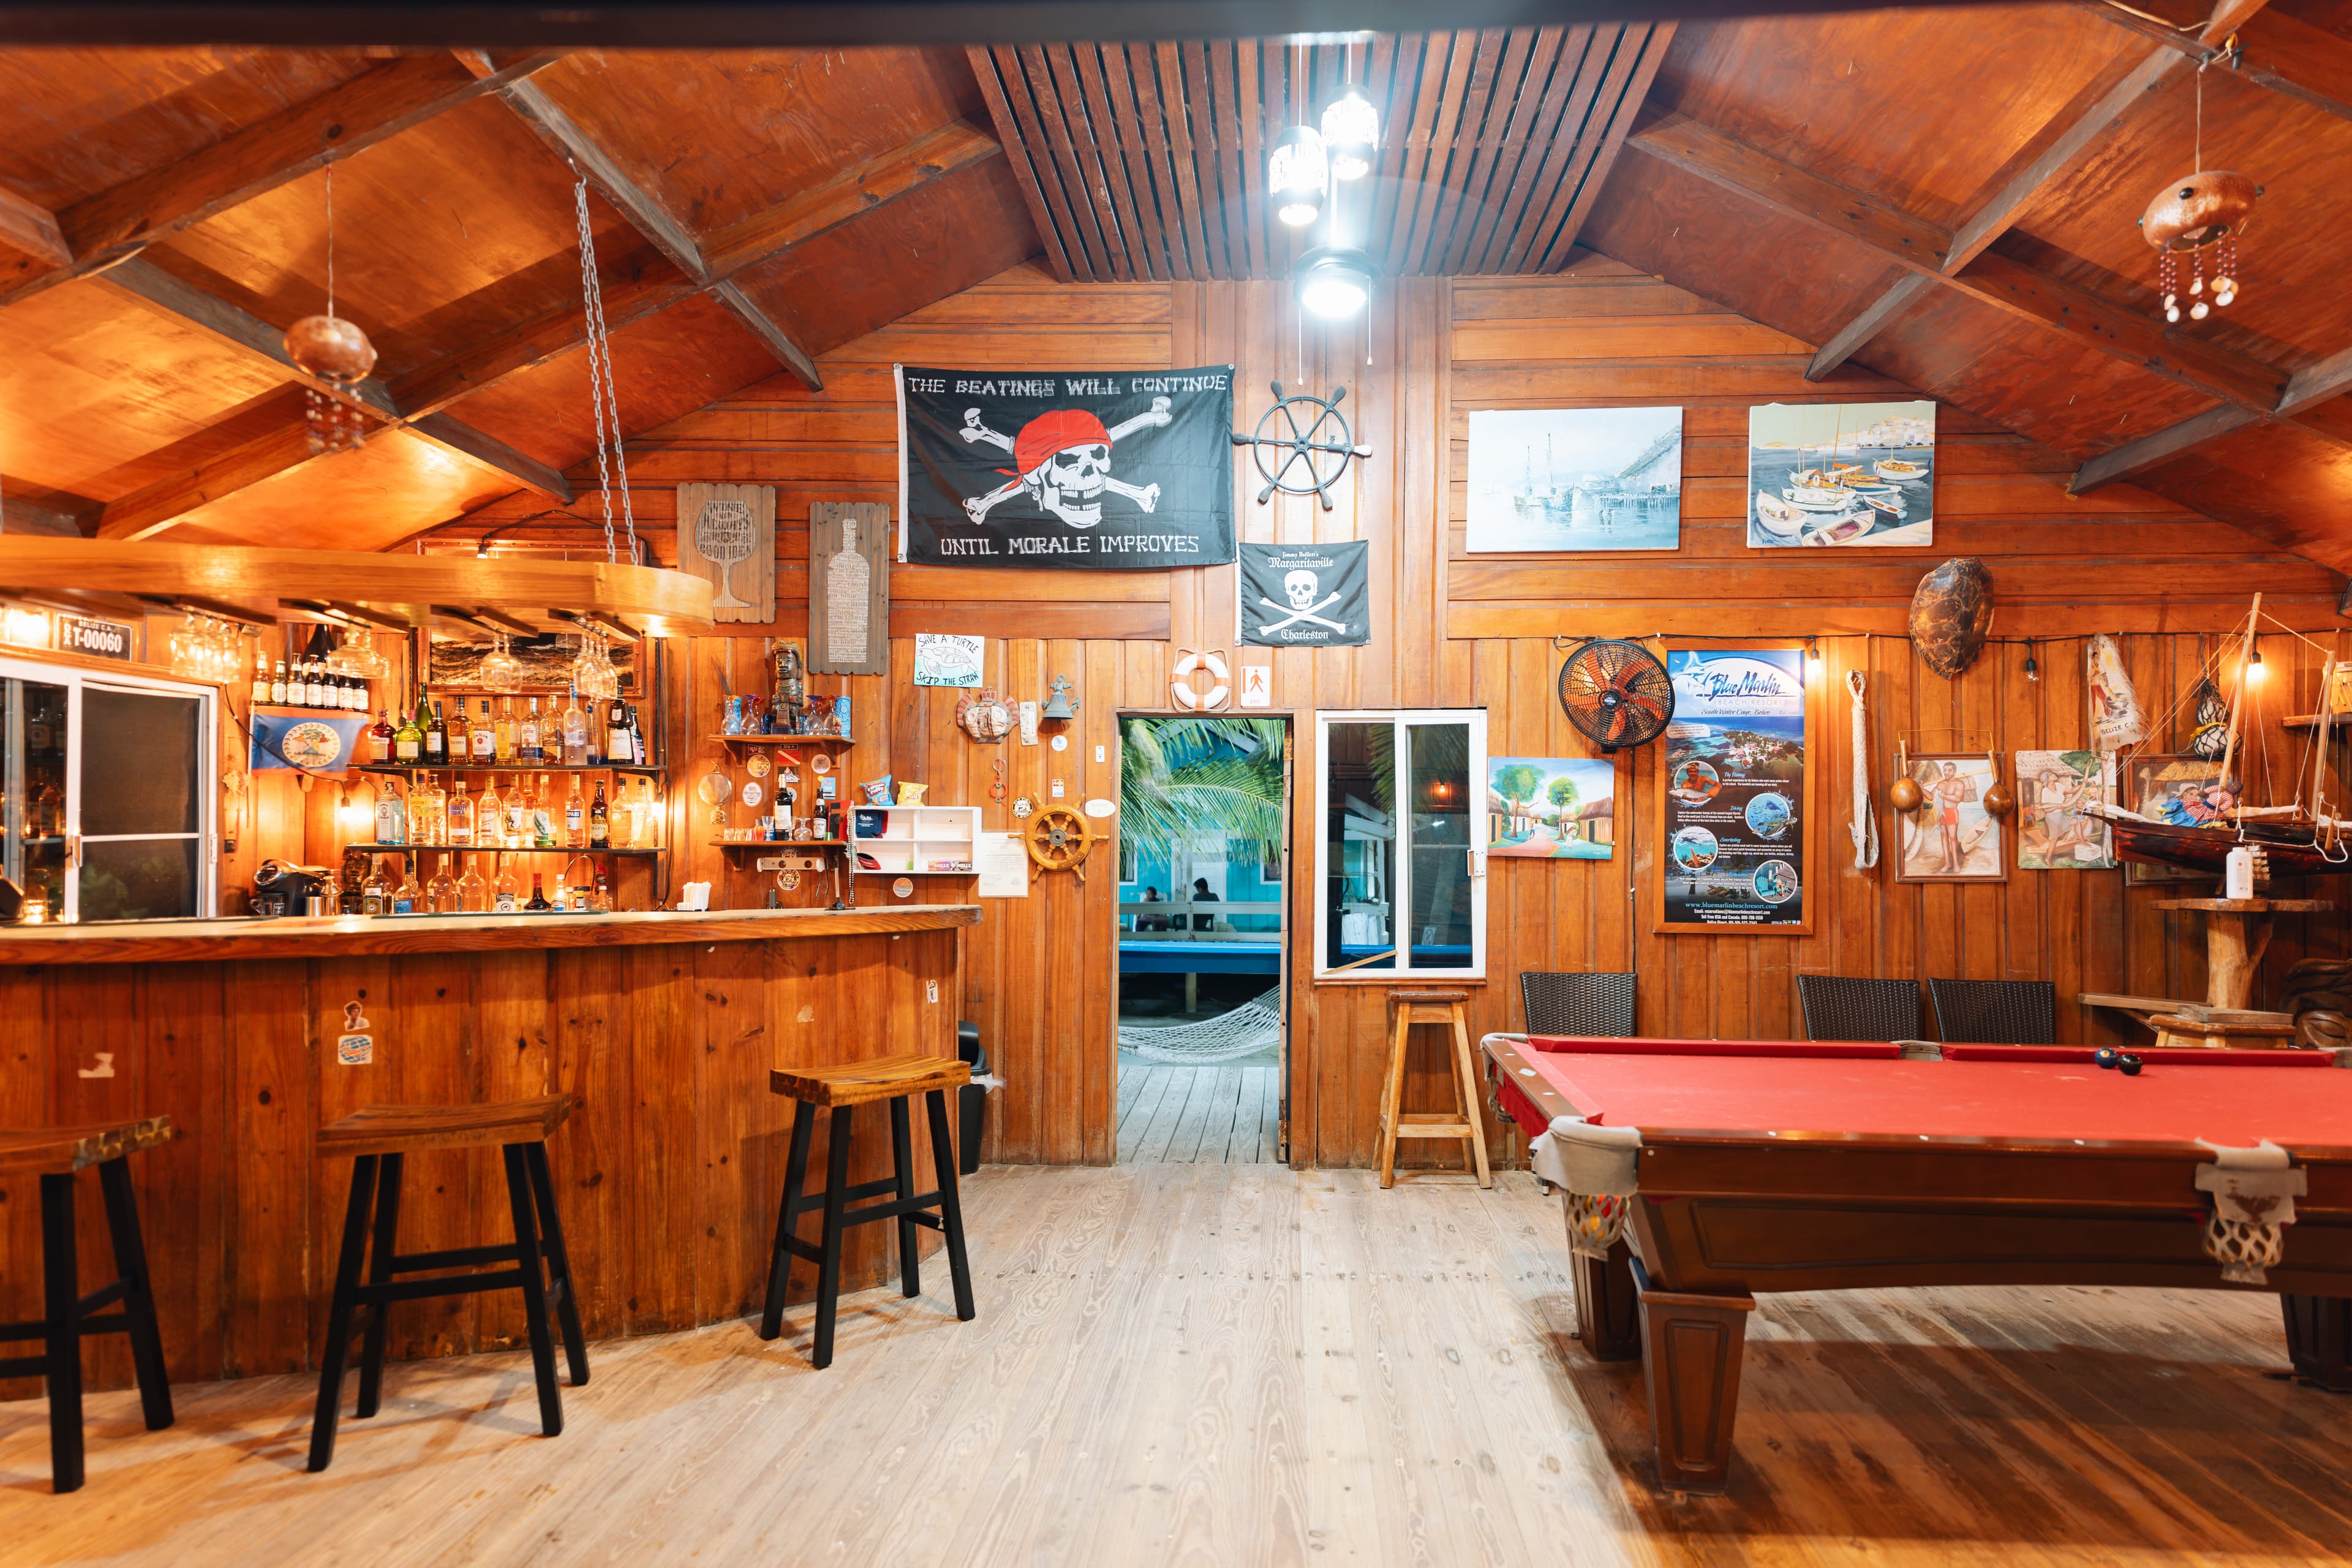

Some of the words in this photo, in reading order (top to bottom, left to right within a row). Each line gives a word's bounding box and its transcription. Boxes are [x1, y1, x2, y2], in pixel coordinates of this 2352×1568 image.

[908, 377, 946, 394] THE
[954, 378, 1055, 398] BEATINGS
[1066, 377, 1121, 396] WILL
[1131, 374, 1228, 393] CONTINUE
[941, 538, 999, 556] UNTIL
[1008, 536, 1090, 555] MORALE
[1100, 535, 1200, 554] IMPROVES
[1268, 557, 1333, 570] Margaritaville
[78, 620, 100, 630] BELIZE
[73, 627, 123, 653] T-00060
[1281, 629, 1329, 641] Charleston
[918, 635, 937, 647] SAVE
[941, 635, 948, 644] A
[952, 636, 979, 654] TURTLE
[916, 671, 940, 685] SKIP
[959, 671, 979, 685] STRAW
[1709, 673, 1736, 702] Blue
[1736, 671, 1786, 697] Marlin
[2101, 725, 2122, 735] BELIZE
